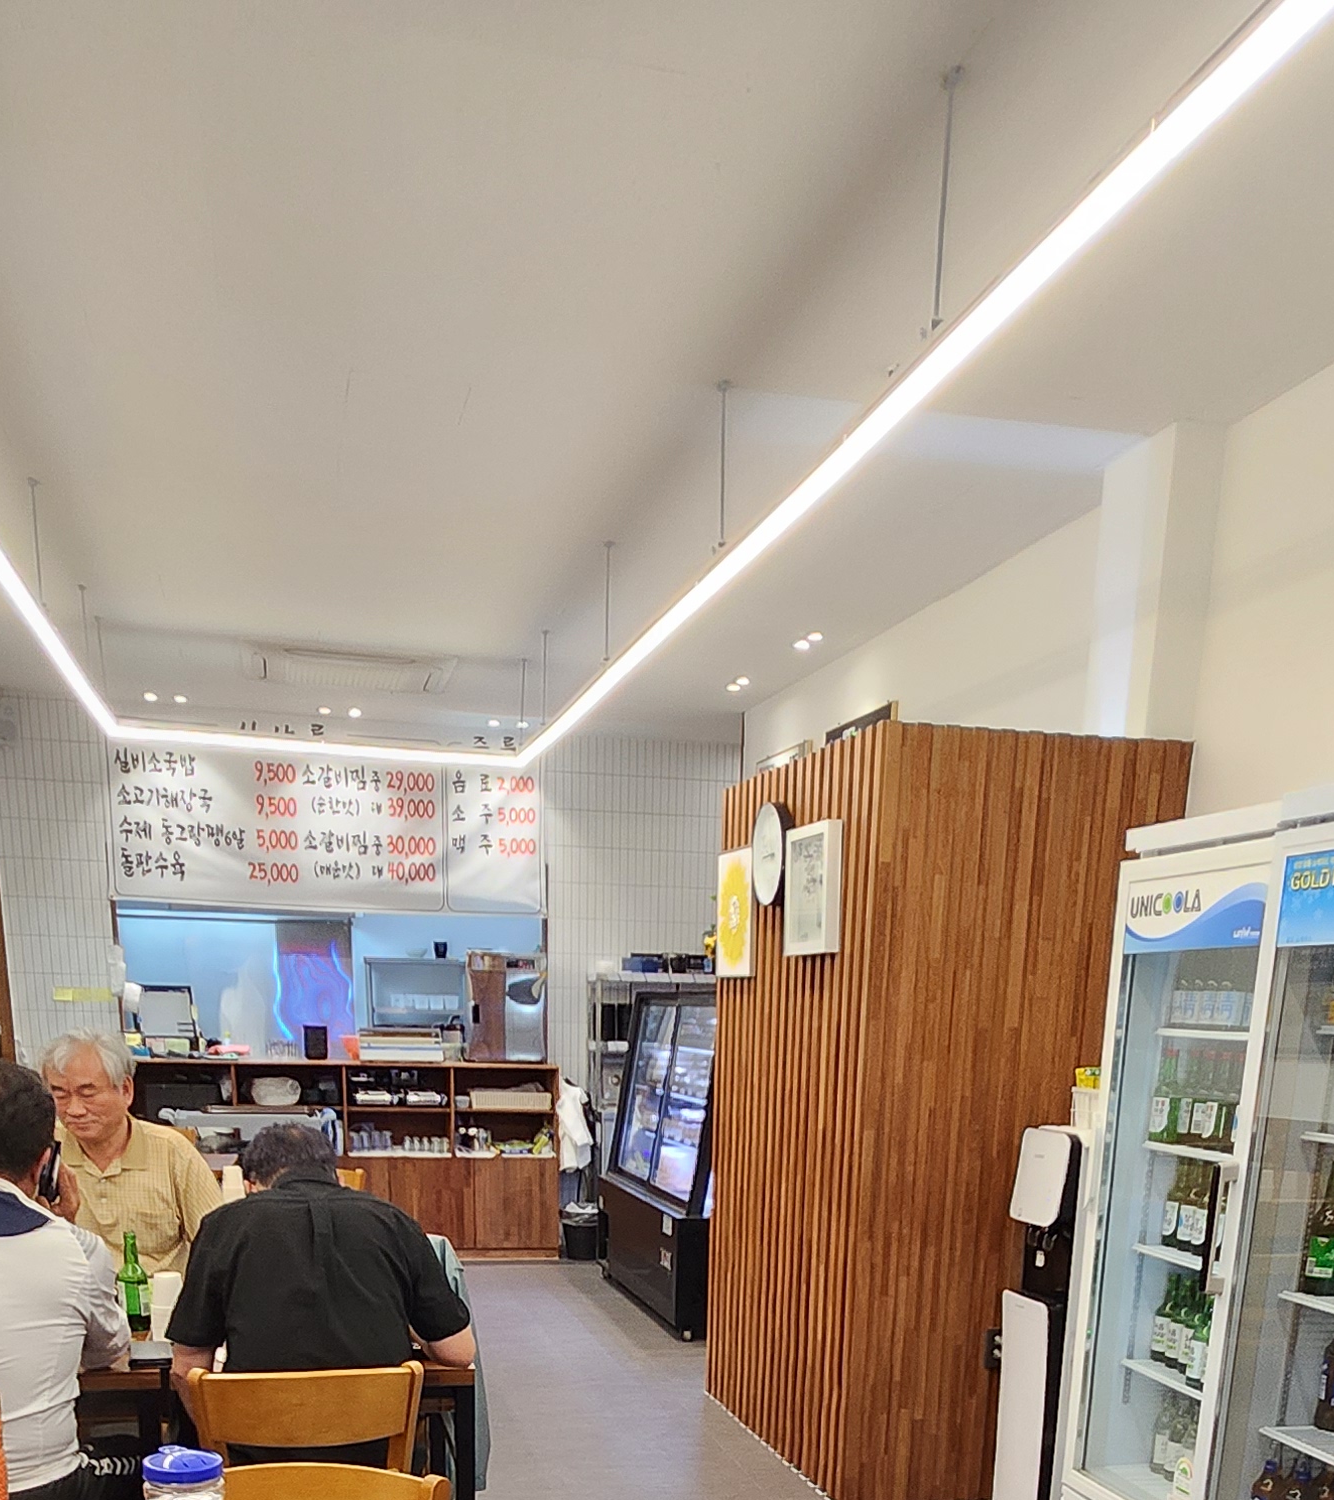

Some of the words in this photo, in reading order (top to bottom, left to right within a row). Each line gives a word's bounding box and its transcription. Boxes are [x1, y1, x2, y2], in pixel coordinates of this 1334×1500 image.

[114, 747, 196, 777] 실비소국밥
[254, 760, 296, 787] 9,500
[302, 763, 366, 791] 소갈비찜
[386, 770, 435, 796] 29,000
[496, 775, 534, 795] 2,000
[117, 783, 212, 812] 소고기해장국
[256, 794, 297, 820] 9,500
[312, 796, 360, 816] (순한맛)
[387, 796, 435, 822] 39,000
[498, 807, 536, 827] 5,000
[119, 816, 152, 842] 수제
[256, 829, 298, 853] 5,000
[304, 829, 368, 856] 소갈비찜
[387, 834, 436, 859] 30,000
[498, 838, 536, 858] 5,000
[120, 847, 185, 881] 돌판수육
[248, 862, 299, 886] 25,000
[314, 860, 360, 880] (매운맛)
[388, 861, 436, 886] 40,000
[1291, 866, 1330, 891] GOLD
